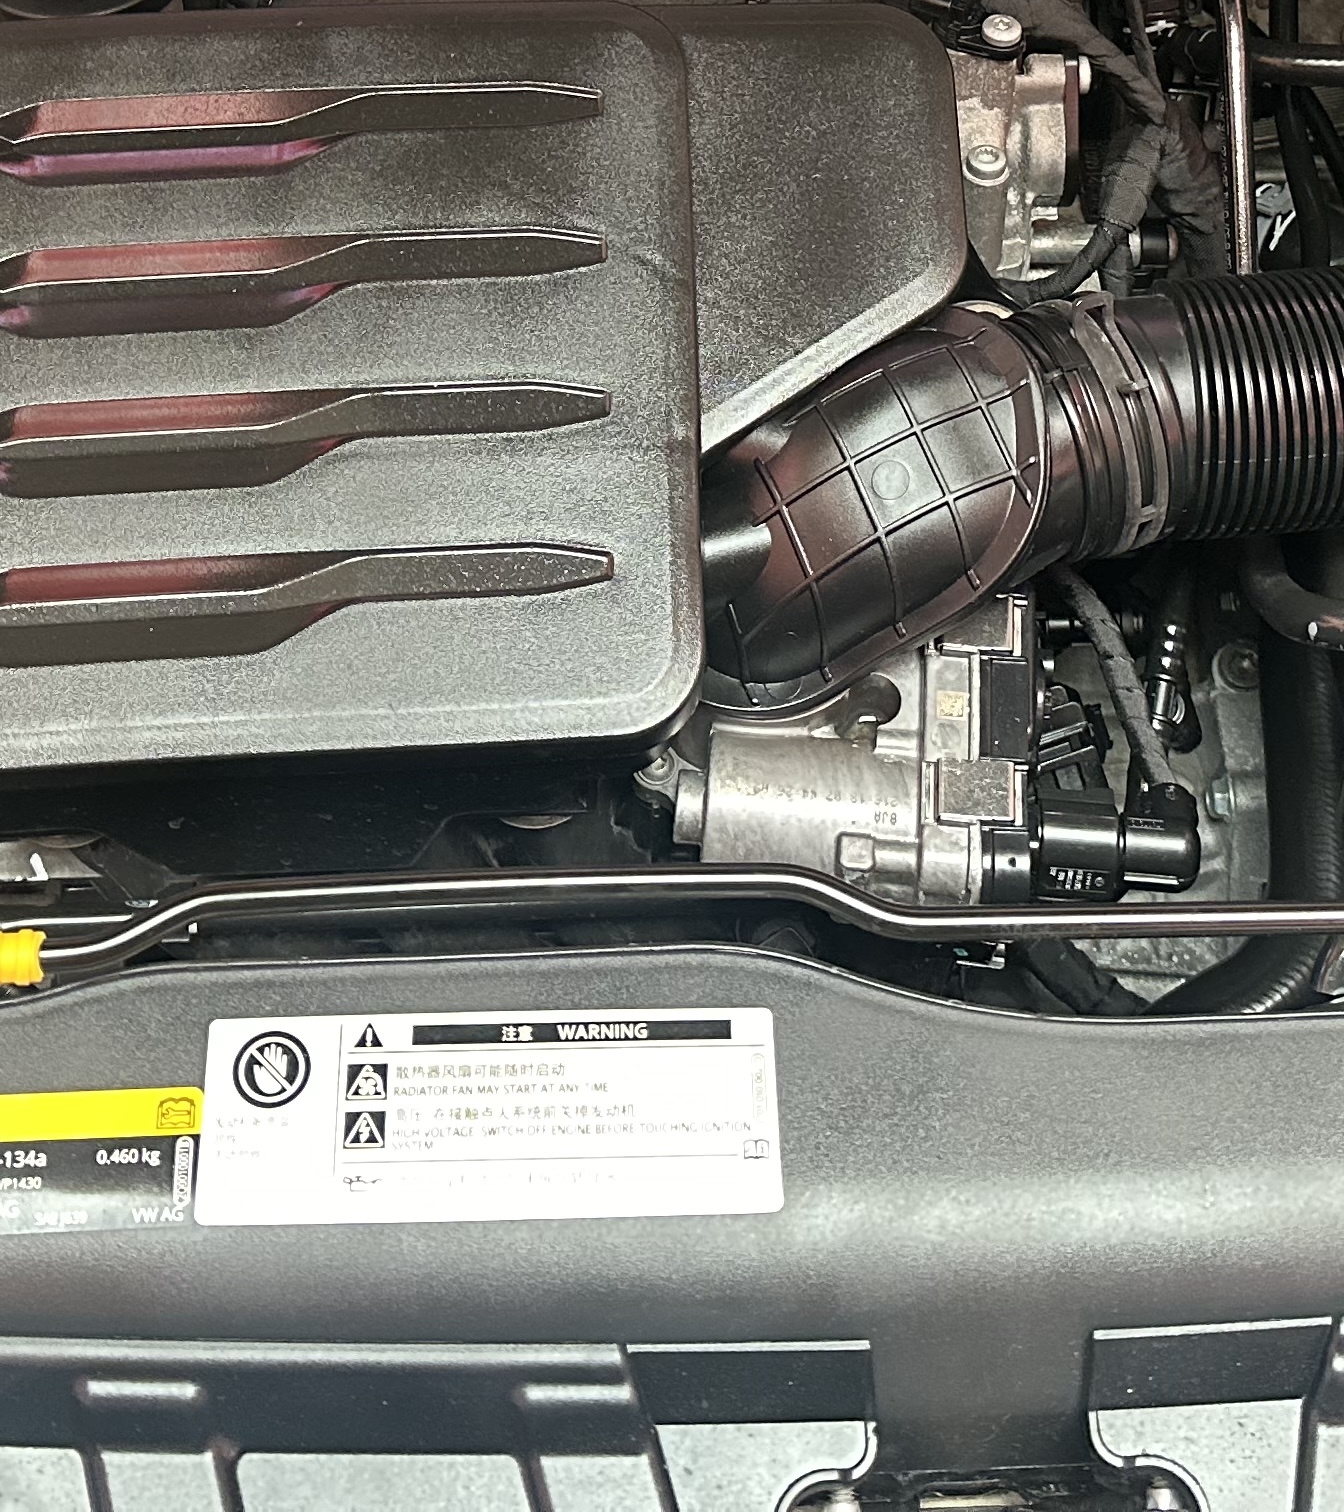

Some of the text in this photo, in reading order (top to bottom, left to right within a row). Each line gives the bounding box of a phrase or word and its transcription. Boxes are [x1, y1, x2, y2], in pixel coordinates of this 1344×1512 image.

[501, 1023, 649, 1042] 注意 WARNING
[393, 1086, 448, 1097] RADIATOR
[452, 1085, 473, 1096] FAN
[477, 1085, 500, 1095] MAY
[504, 1084, 538, 1094] START
[541, 1083, 554, 1093] AT
[559, 1083, 580, 1093] ANY
[424, 1126, 473, 1138] VOLTAGE
[551, 1124, 591, 1135] ENGINE
[595, 1123, 635, 1134] BEFORE
[96, 1148, 138, 1166] 0.460
[141, 1148, 161, 1167] kg
[131, 1207, 157, 1224] VW
[160, 1206, 185, 1223] AG
